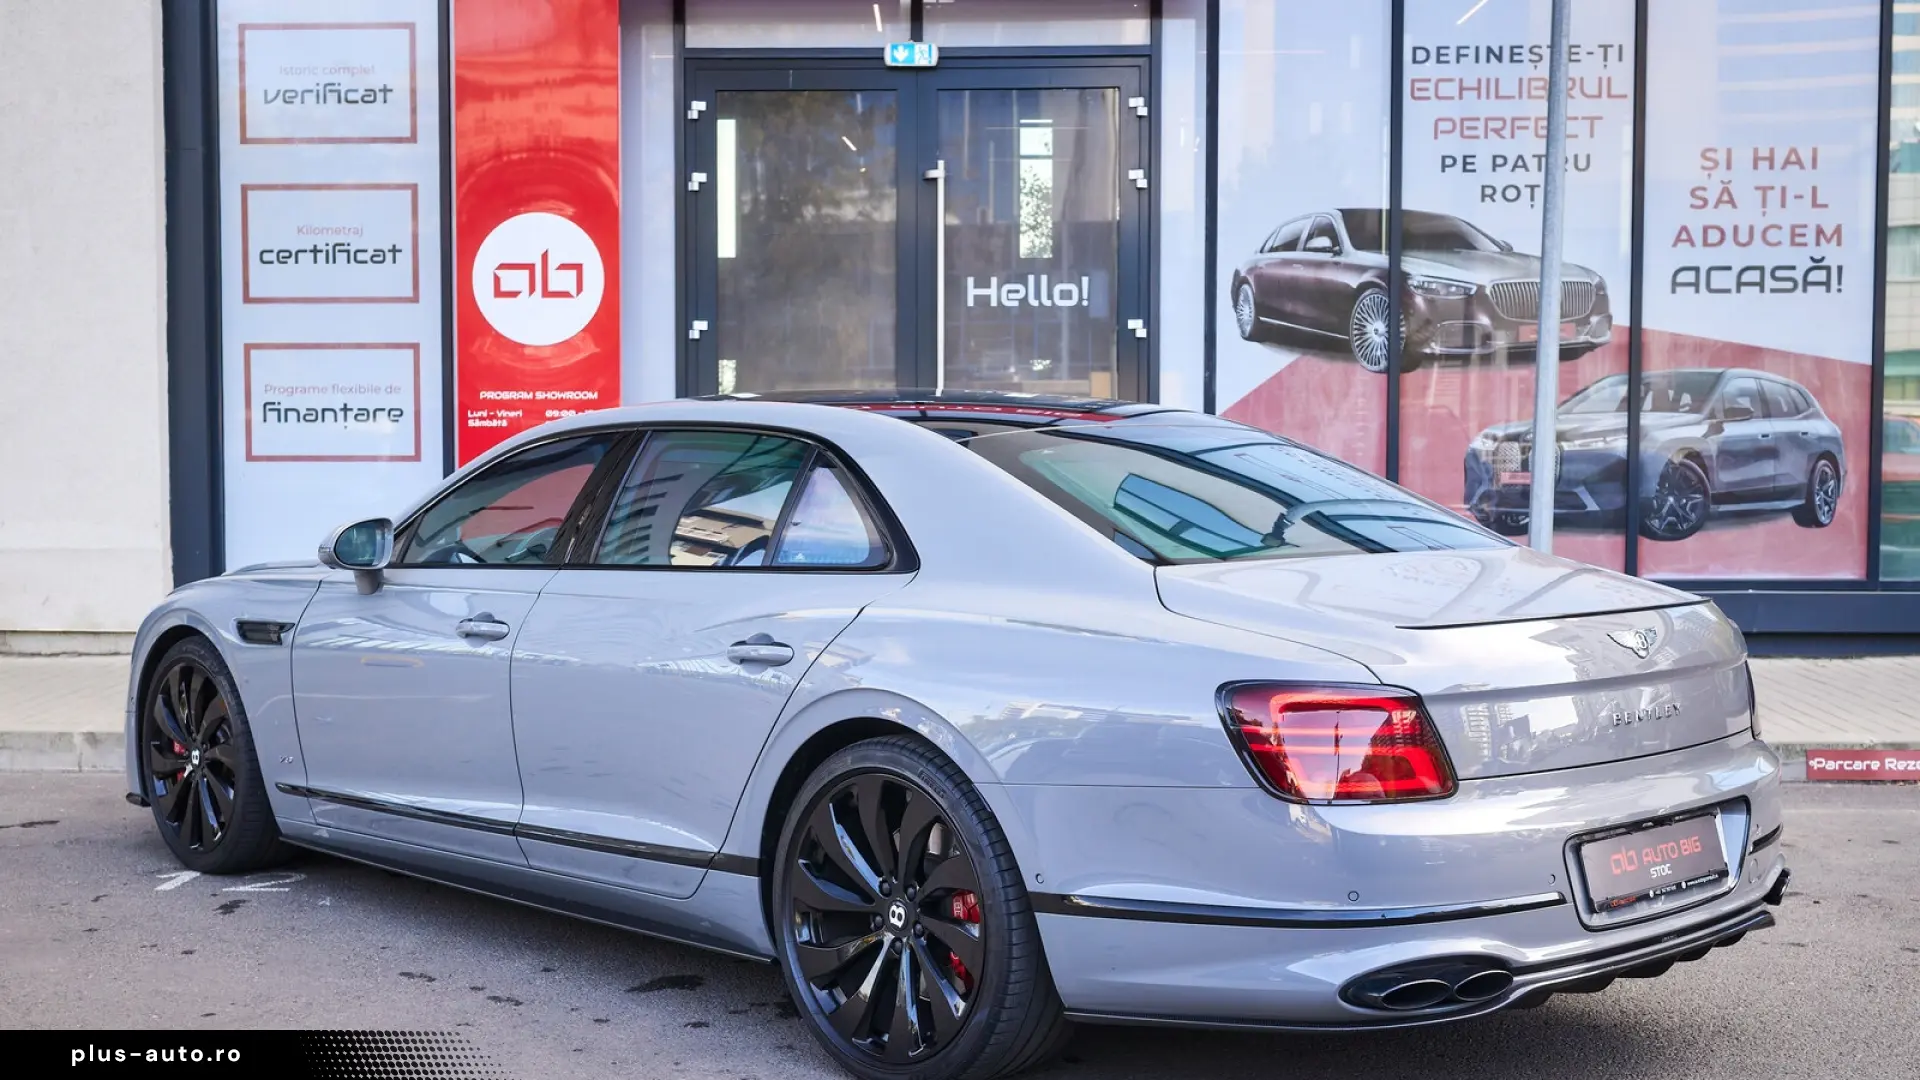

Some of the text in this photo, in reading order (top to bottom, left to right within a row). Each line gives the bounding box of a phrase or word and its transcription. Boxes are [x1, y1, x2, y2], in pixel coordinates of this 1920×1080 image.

[1411, 44, 1623, 70] DEFINEȘE-ȚI
[279, 65, 375, 77] Istoric complet
[263, 82, 393, 104] verificat
[1440, 153, 1591, 173] PE PATU
[1700, 147, 1818, 180] ȘI HAI
[1689, 179, 1829, 217] SĂ ȚI-L
[297, 225, 364, 238] Kilometraj
[1671, 223, 1843, 248] ADUCEM
[259, 242, 402, 264] certificat
[1670, 256, 1843, 294] ACASĂ!
[966, 274, 1089, 307] Hello!
[264, 384, 402, 397] Programe flexibile de
[479, 391, 598, 400] PROGRAM SHOWROOM
[262, 402, 404, 429] finanțare
[467, 409, 487, 418] Luni
[496, 409, 523, 418] Vineri
[1613, 703, 1681, 727] BENTLEY
[1813, 757, 1880, 770] Parcare
[1642, 842, 1679, 865] AUTO
[1680, 836, 1702, 856] BIG
[1649, 863, 1673, 879] STOC
